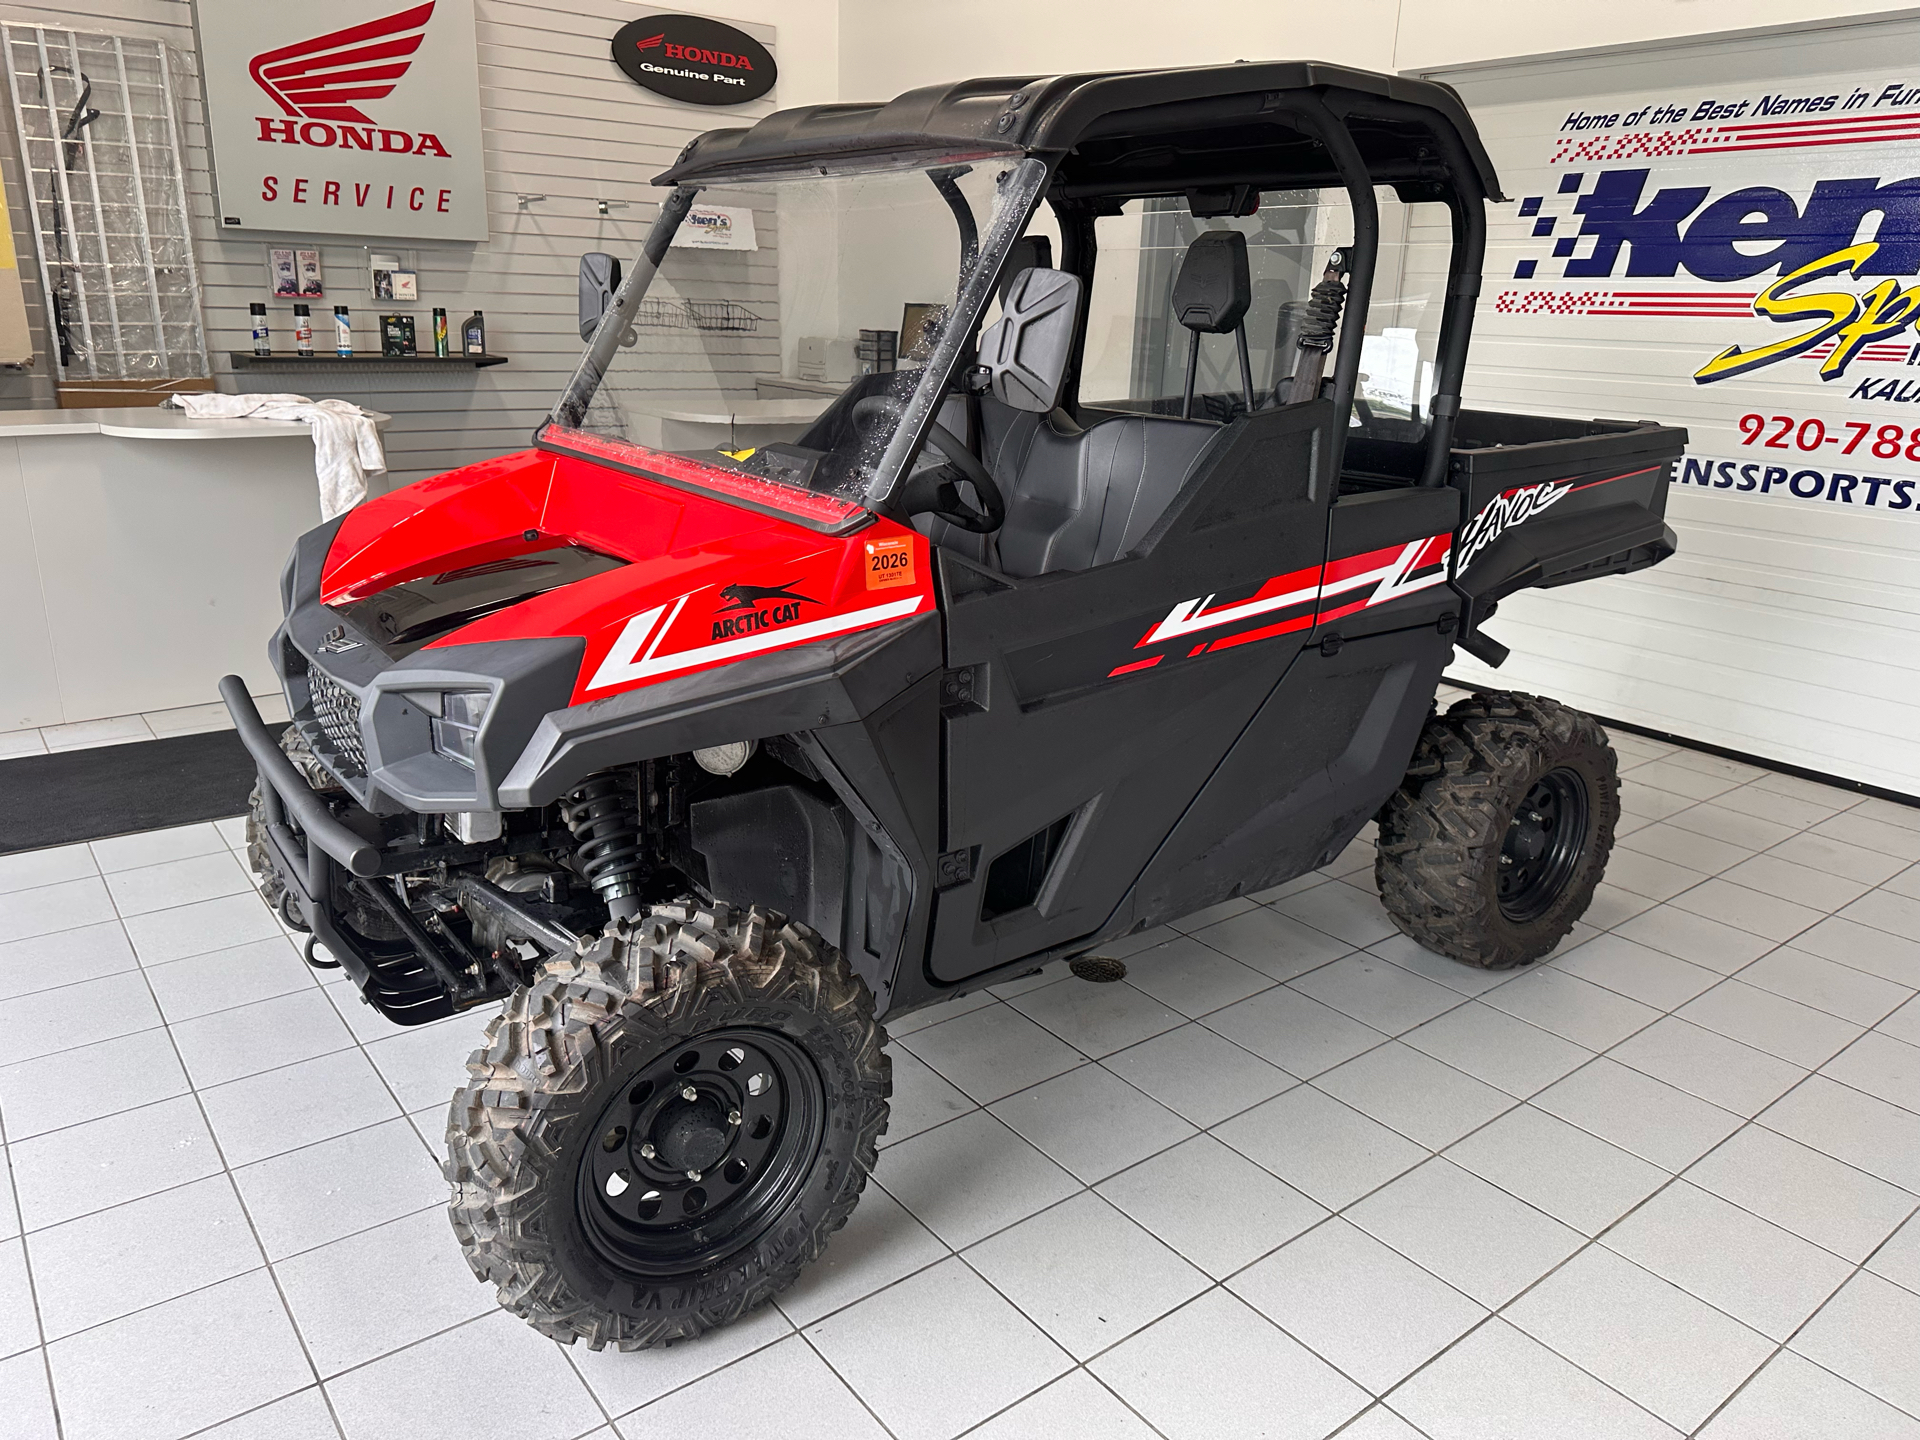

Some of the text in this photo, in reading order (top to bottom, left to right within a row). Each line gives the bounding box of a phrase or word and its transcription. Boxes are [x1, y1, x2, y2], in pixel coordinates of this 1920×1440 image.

[640, 62, 746, 86] Genuine Part
[664, 43, 754, 71] HONDA
[1560, 111, 1620, 132] Home
[1622, 105, 1652, 127] of
[1649, 104, 1688, 125] the
[1689, 100, 1750, 122] Best
[1751, 94, 1840, 117] Names
[1841, 88, 1870, 110] in
[254, 116, 452, 158] HONDA
[261, 175, 452, 213] SERVICE
[1693, 241, 1920, 385] Sp
[1848, 377, 1920, 403] KAU
[871, 552, 908, 571] 2026
[711, 601, 801, 640] ARCTIC CAT
[688, 1006, 795, 1034] DURO
[739, 1211, 812, 1285] POWER
